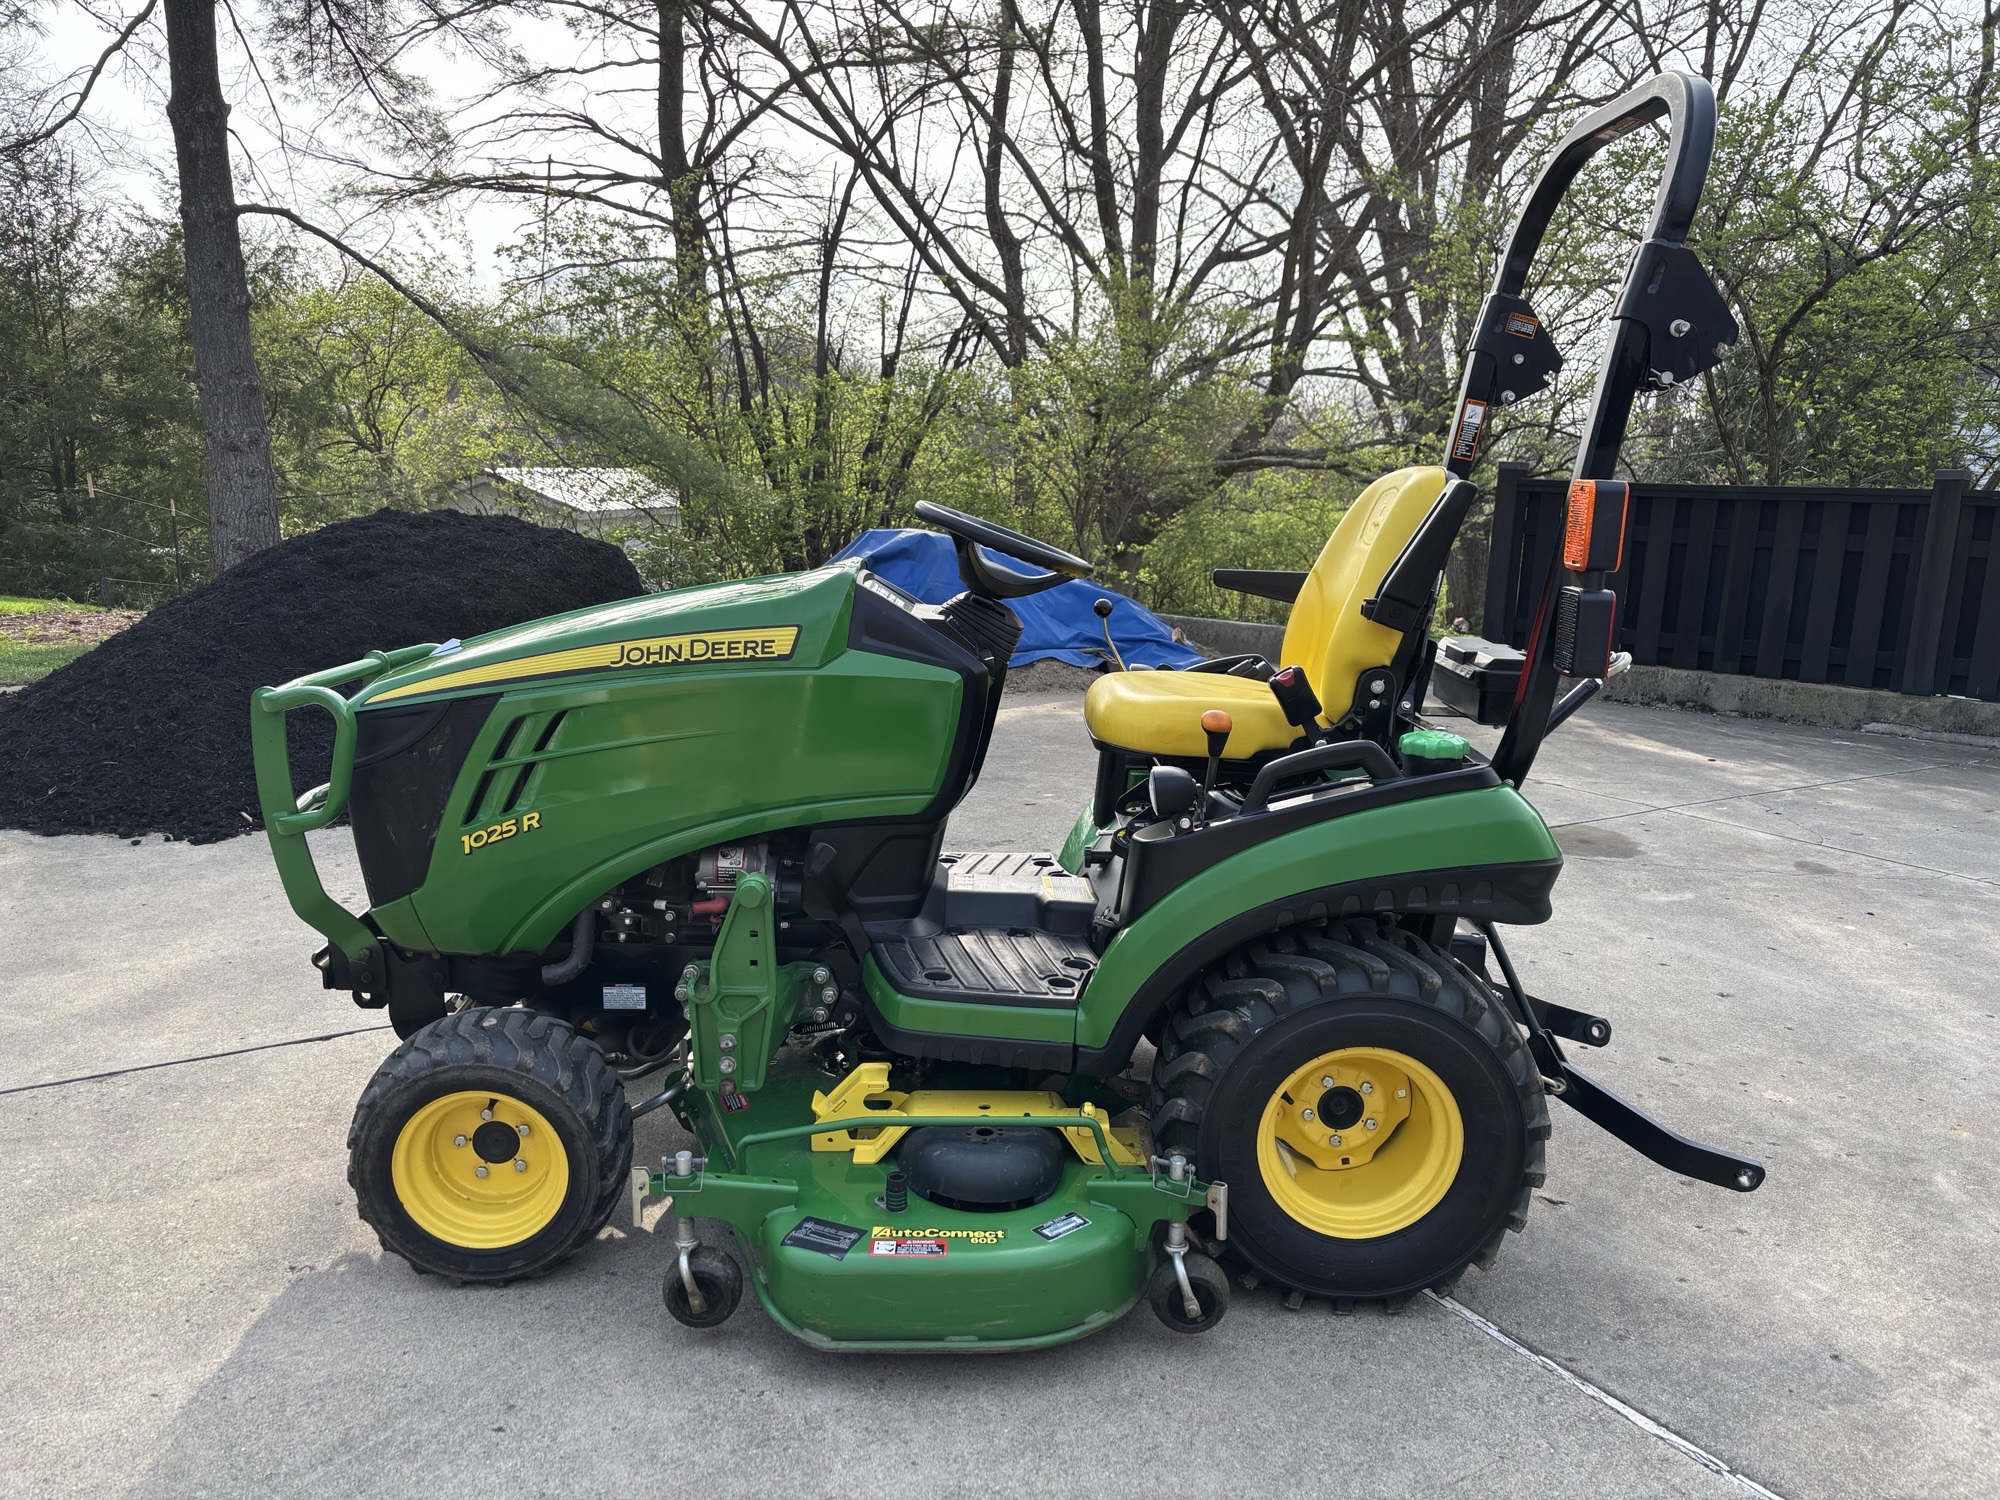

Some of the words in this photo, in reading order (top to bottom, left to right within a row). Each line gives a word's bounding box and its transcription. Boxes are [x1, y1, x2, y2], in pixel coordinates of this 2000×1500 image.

[610, 644, 683, 665] JOHN
[690, 639, 776, 659] DEERE
[461, 819, 518, 855] 1025
[523, 812, 541, 832] R
[872, 1226, 1005, 1239] AutoConnect
